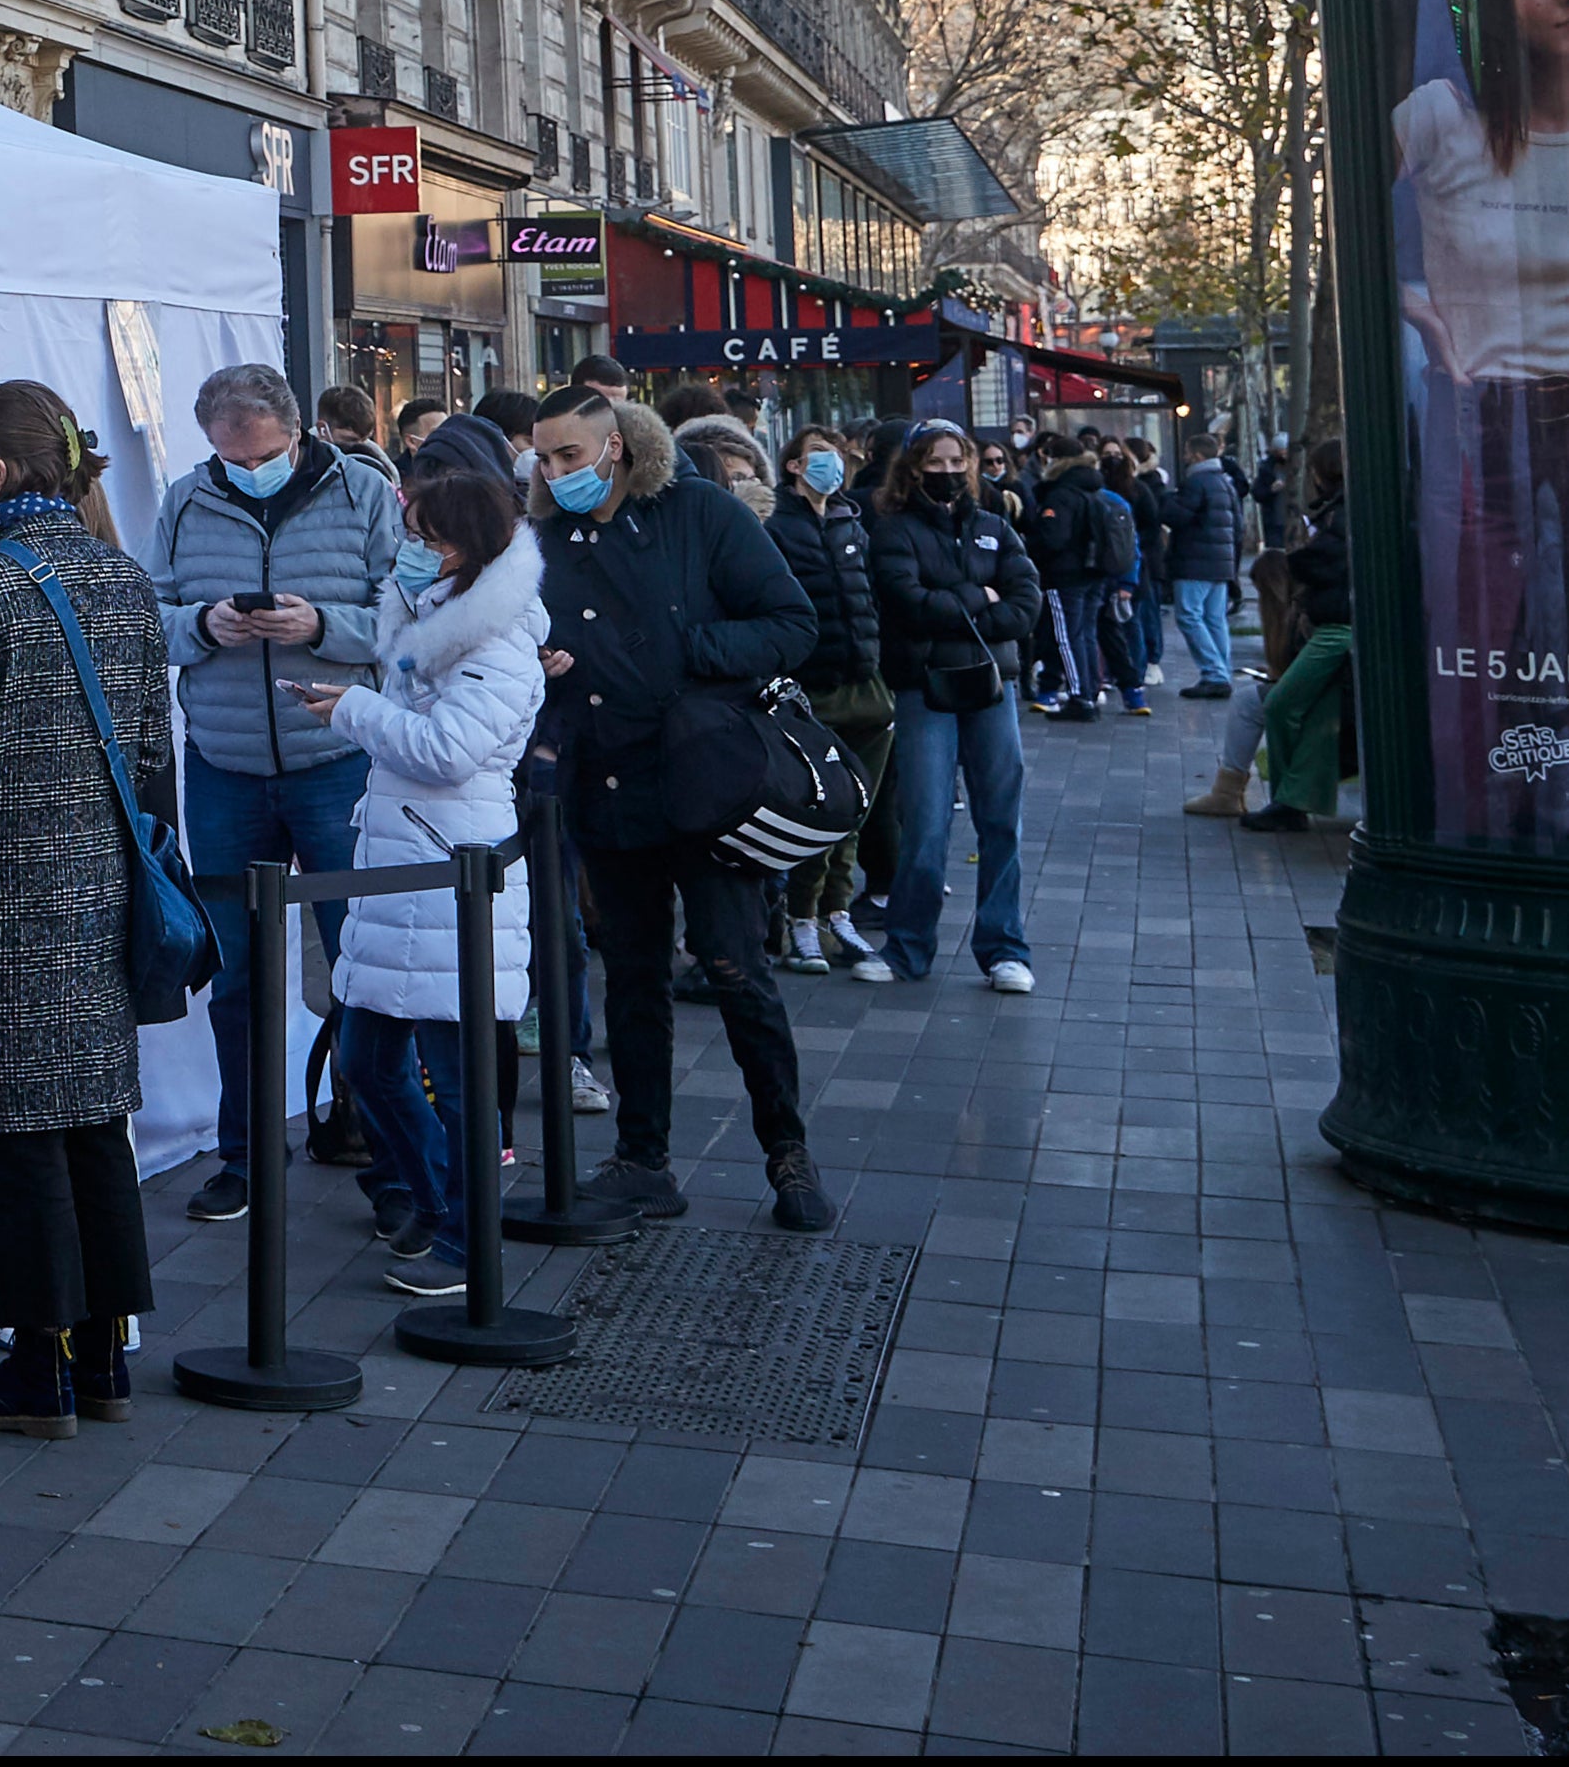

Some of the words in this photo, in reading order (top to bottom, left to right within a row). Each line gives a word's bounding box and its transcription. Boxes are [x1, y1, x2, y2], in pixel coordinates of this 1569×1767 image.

[261, 121, 294, 196] SFR
[349, 155, 415, 185] SFR
[424, 214, 457, 273] Etam
[512, 227, 597, 254] Etam
[723, 332, 842, 362] CAFÉ
[1435, 646, 1478, 677] LE
[1487, 650, 1507, 680] 5
[1516, 651, 1569, 683] JA
[1505, 728, 1553, 750] SENS
[1492, 744, 1569, 768] CRITIQUE
